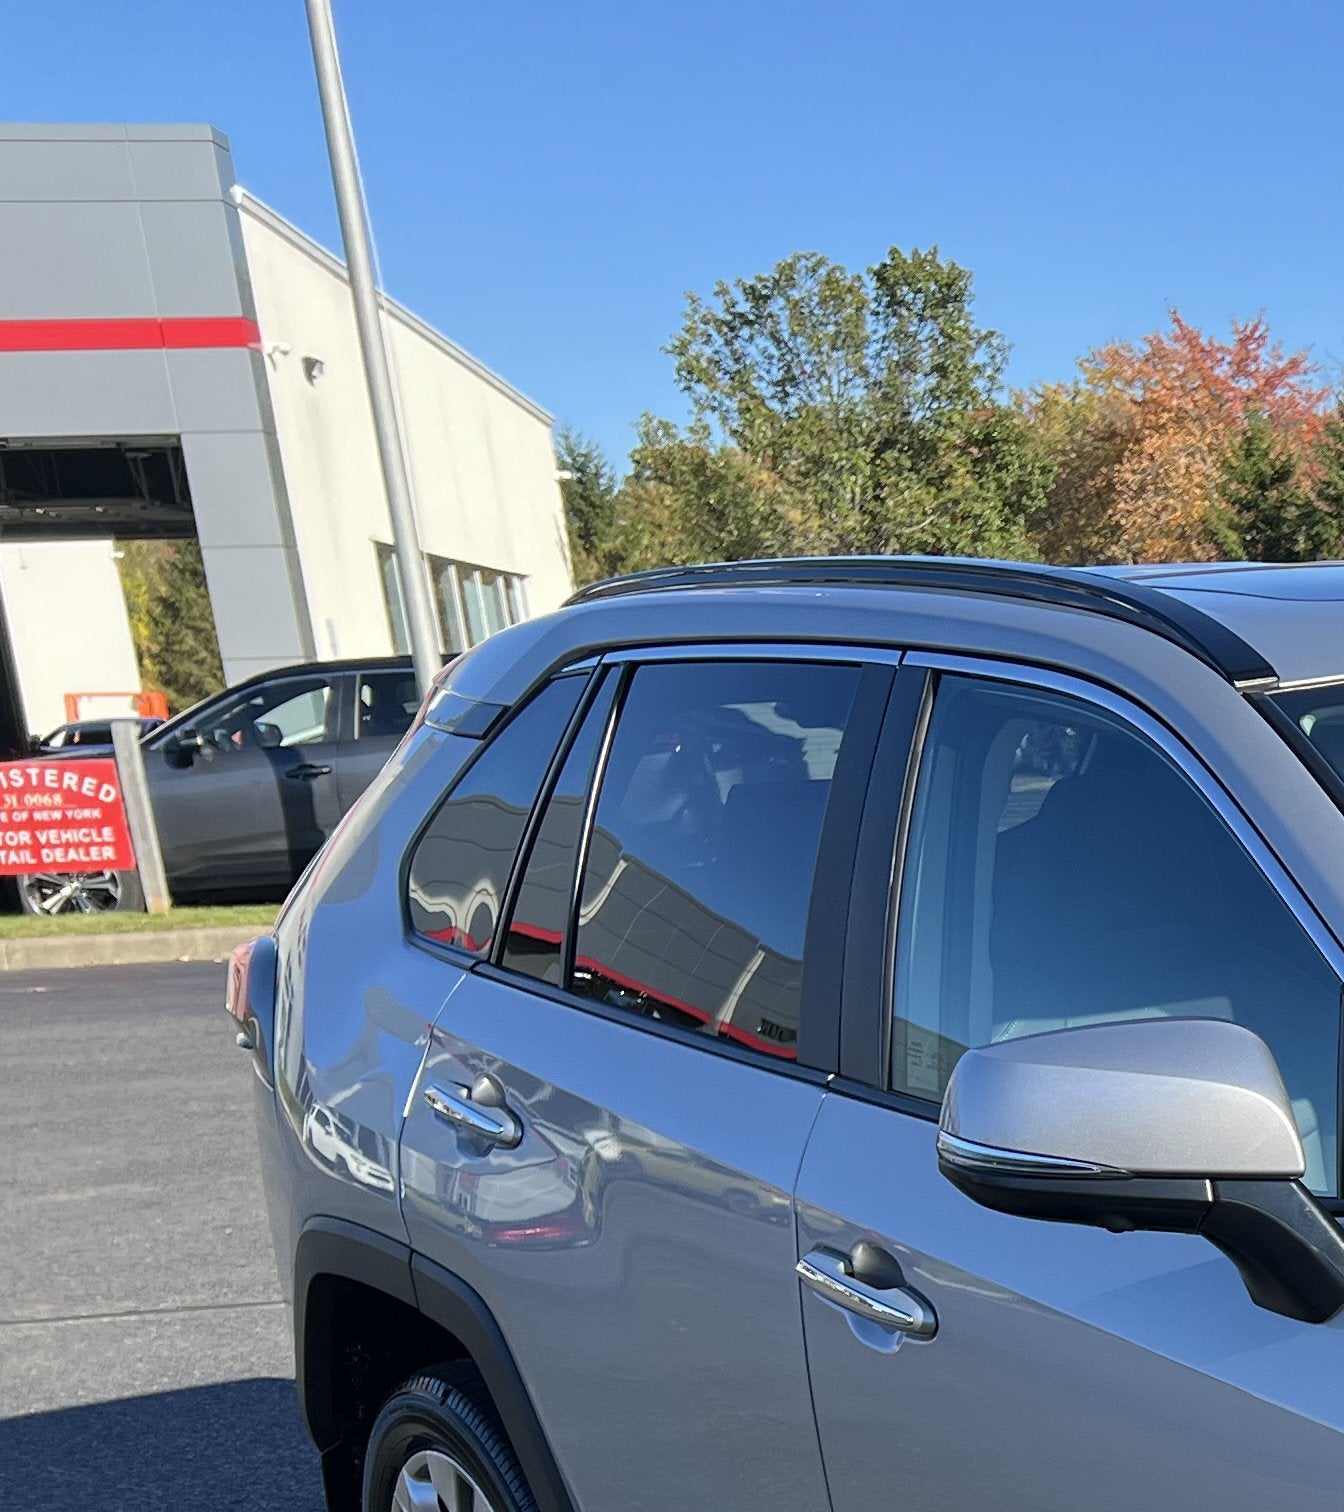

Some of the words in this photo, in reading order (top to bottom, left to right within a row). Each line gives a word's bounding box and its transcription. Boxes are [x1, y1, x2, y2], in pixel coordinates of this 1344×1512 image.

[12, 811, 28, 822] OF
[33, 810, 62, 821] NEW
[65, 808, 102, 820] YORK
[35, 826, 114, 844] VEHICLE
[41, 846, 116, 863] DEALER
